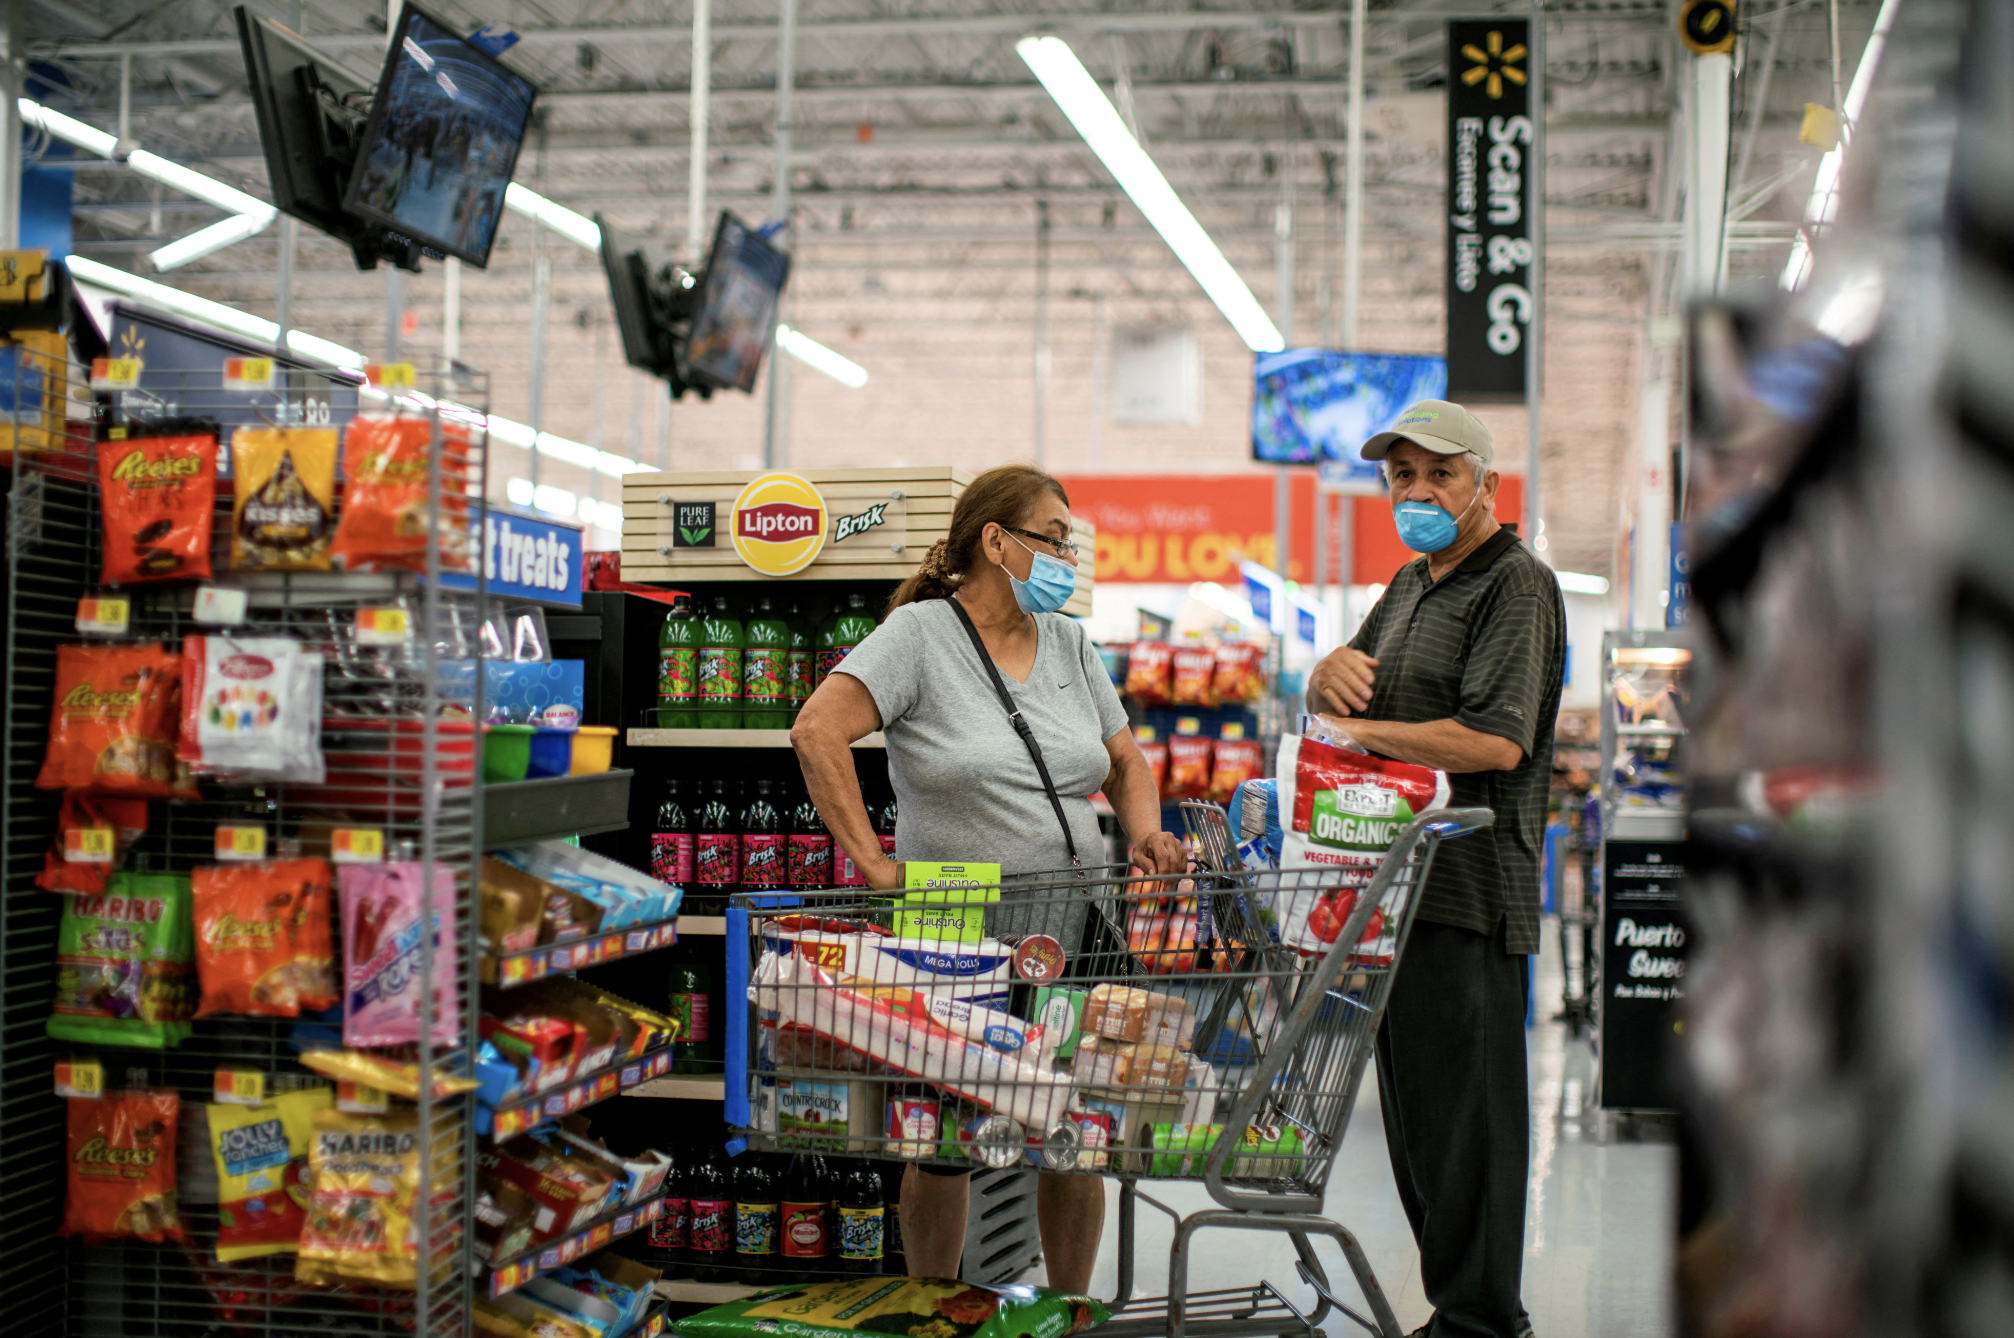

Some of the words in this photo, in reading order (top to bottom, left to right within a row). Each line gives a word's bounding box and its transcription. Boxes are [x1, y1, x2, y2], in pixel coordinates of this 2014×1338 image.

[1486, 114, 1534, 226] Scan
[1449, 213, 1478, 233] y
[1455, 233, 1484, 293] Listo
[1486, 234, 1534, 276] &
[1485, 282, 1534, 356] Go
[112, 449, 203, 481] Reese's
[680, 506, 710, 516] PURE
[680, 516, 709, 526] LEAF
[744, 511, 813, 536] Lipton
[500, 521, 569, 591] treats
[1094, 531, 1159, 580] OU
[61, 683, 142, 707] Reese's
[749, 845, 776, 866] Brisk
[1304, 851, 1360, 866] VEGETABLE
[1363, 857, 1371, 866] &
[926, 878, 981, 891] Outshine
[70, 895, 166, 924] HARIBO
[913, 916, 966, 930] Outshine
[1614, 917, 1686, 947] Puerto
[819, 946, 843, 966] 72
[925, 955, 952, 969] MEGA
[955, 958, 980, 969] ROLLS
[1627, 948, 1687, 978] Swee
[933, 1007, 969, 1023] Garlic
[935, 999, 970, 1014] Bread
[1052, 1004, 1062, 1028] altine
[988, 1032, 1021, 1049] Great
[991, 1027, 1015, 1039] Value
[1158, 1027, 1178, 1038] ATTIES
[1084, 1064, 1108, 1076] PATIES
[1141, 1075, 1171, 1087] PTTIES
[782, 1093, 815, 1108] CONTRY
[815, 1096, 843, 1114] CROCK
[220, 1121, 279, 1152] JOLLY
[317, 1131, 416, 1158] HARIBO
[74, 1135, 158, 1166] Reese's
[225, 1139, 285, 1163] rancher
[693, 1212, 719, 1231] Brisk
[846, 1219, 874, 1240] Brisk
[794, 1228, 818, 1237] Mundet
